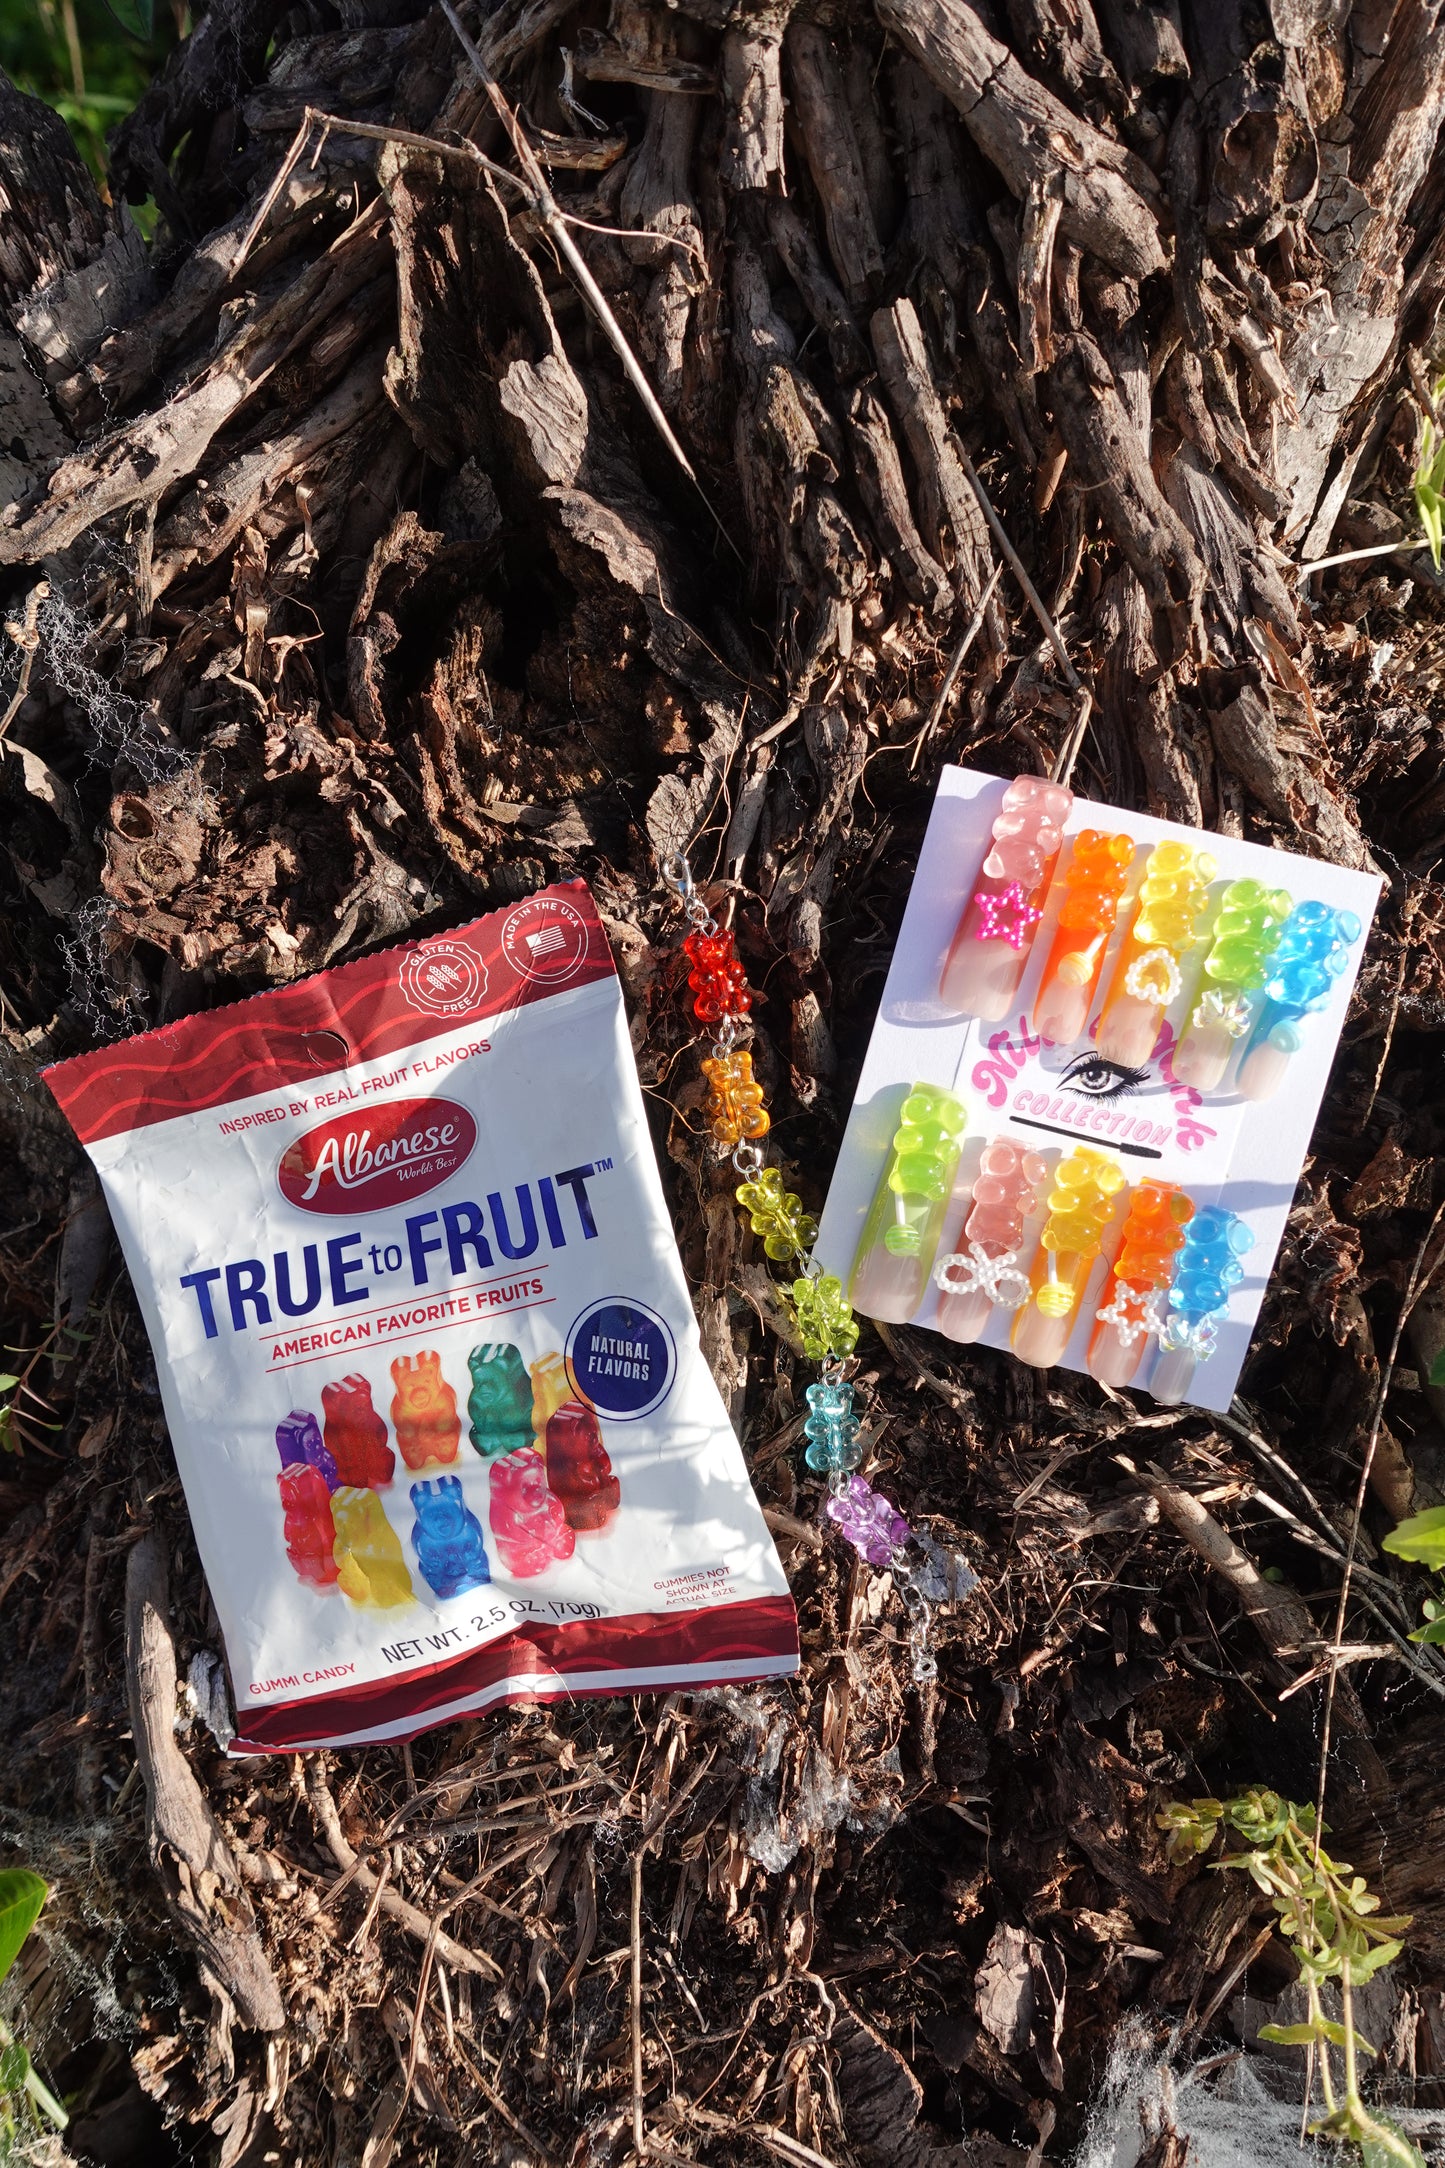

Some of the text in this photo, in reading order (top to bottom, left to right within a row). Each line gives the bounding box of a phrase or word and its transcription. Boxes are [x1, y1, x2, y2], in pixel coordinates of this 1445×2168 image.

[506, 902, 579, 950] MADE IN THE USA
[410, 944, 455, 967] GLUTEN
[442, 996, 473, 1013] FREE
[972, 1014, 1066, 1107] Nil
[218, 1039, 492, 1135] INSPIRED BY REAL FRUIT FLAVORS
[1012, 1089, 1173, 1146] COLLECTION
[300, 1122, 461, 1200] Albanese
[435, 1155, 458, 1170] Best
[179, 1232, 370, 1339] TRUE
[368, 1243, 402, 1276] to
[405, 1163, 599, 1286] FRUIT
[271, 1278, 544, 1360] AMERICAN FAVORITE FRUITS
[591, 1335, 650, 1360] NATURAL
[588, 1356, 649, 1381] FLAVORS
[654, 1566, 730, 1589] GUMMIES NOT
[666, 1579, 726, 1598] SHOWN AT
[711, 1586, 737, 1598] SIZE
[381, 1600, 601, 1664] NET WT. 2.5 OZ. (70g)
[249, 1663, 356, 1695] GUMMI CANDY
